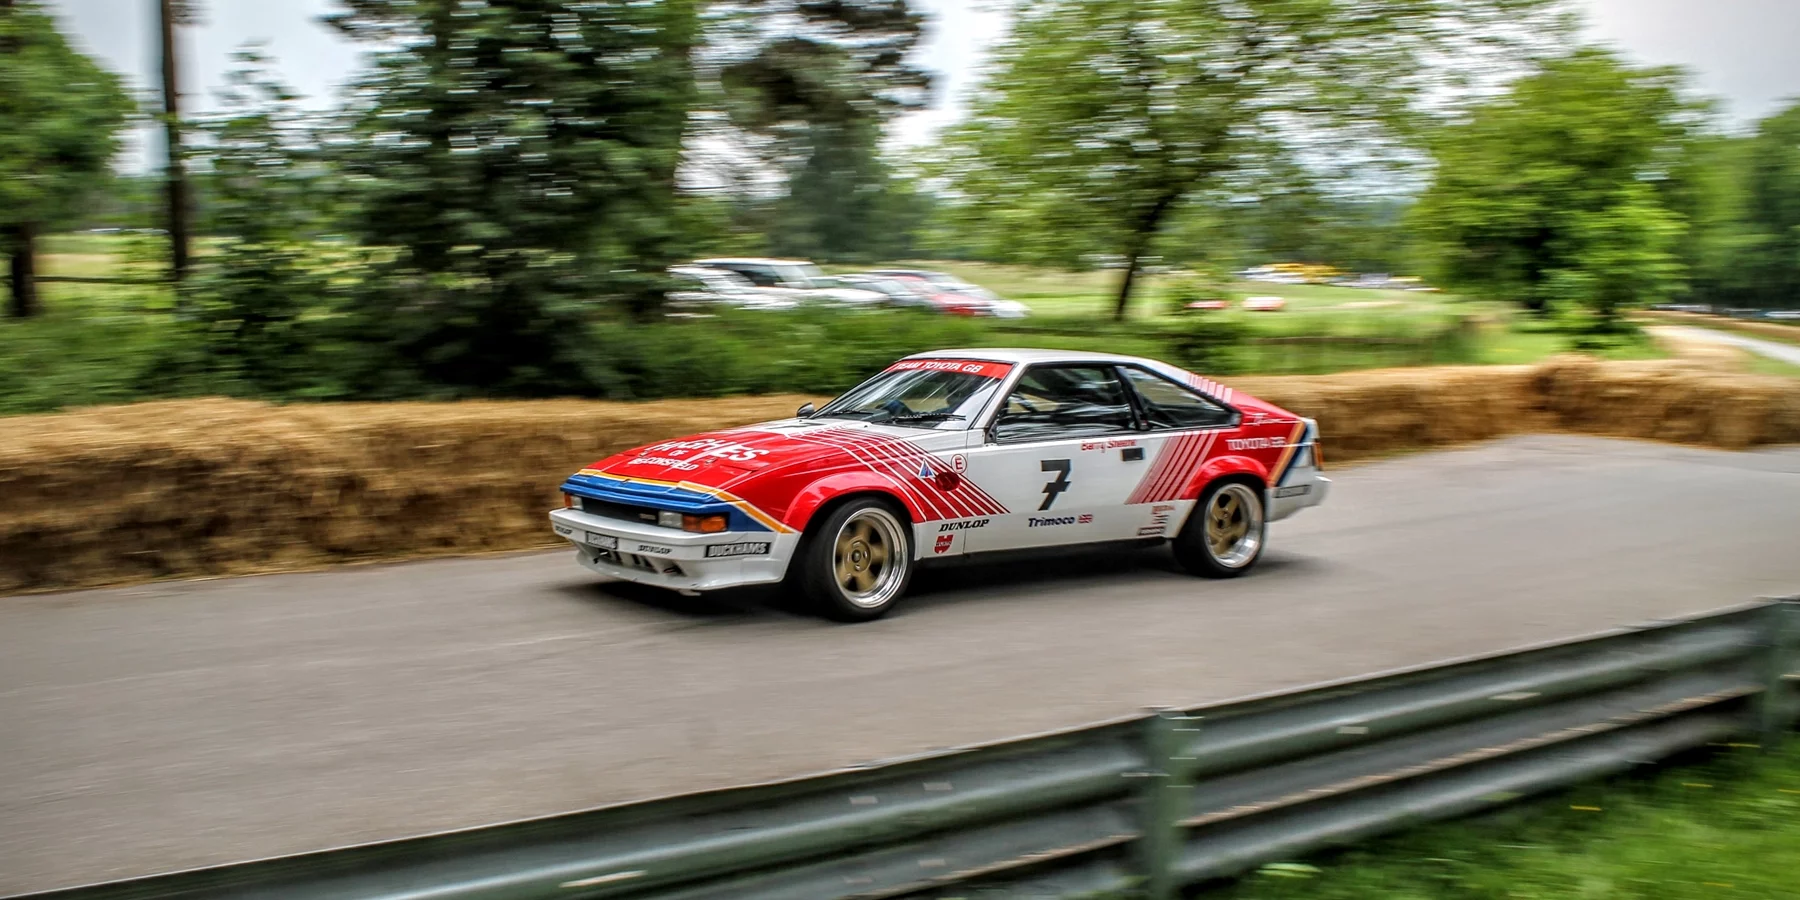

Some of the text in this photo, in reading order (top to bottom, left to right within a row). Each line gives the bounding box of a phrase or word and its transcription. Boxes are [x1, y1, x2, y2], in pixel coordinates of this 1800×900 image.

[897, 361, 984, 373] TEAM TOYOTA GB
[1225, 438, 1269, 451] TOYOTA
[668, 449, 689, 457] OF
[955, 458, 964, 470] E
[1038, 459, 1072, 511] 7
[938, 519, 990, 532] DUNLOP
[1028, 516, 1075, 528] Trimoco
[638, 544, 673, 554] DUNLOP
[708, 543, 767, 557] DUCKHAMS
